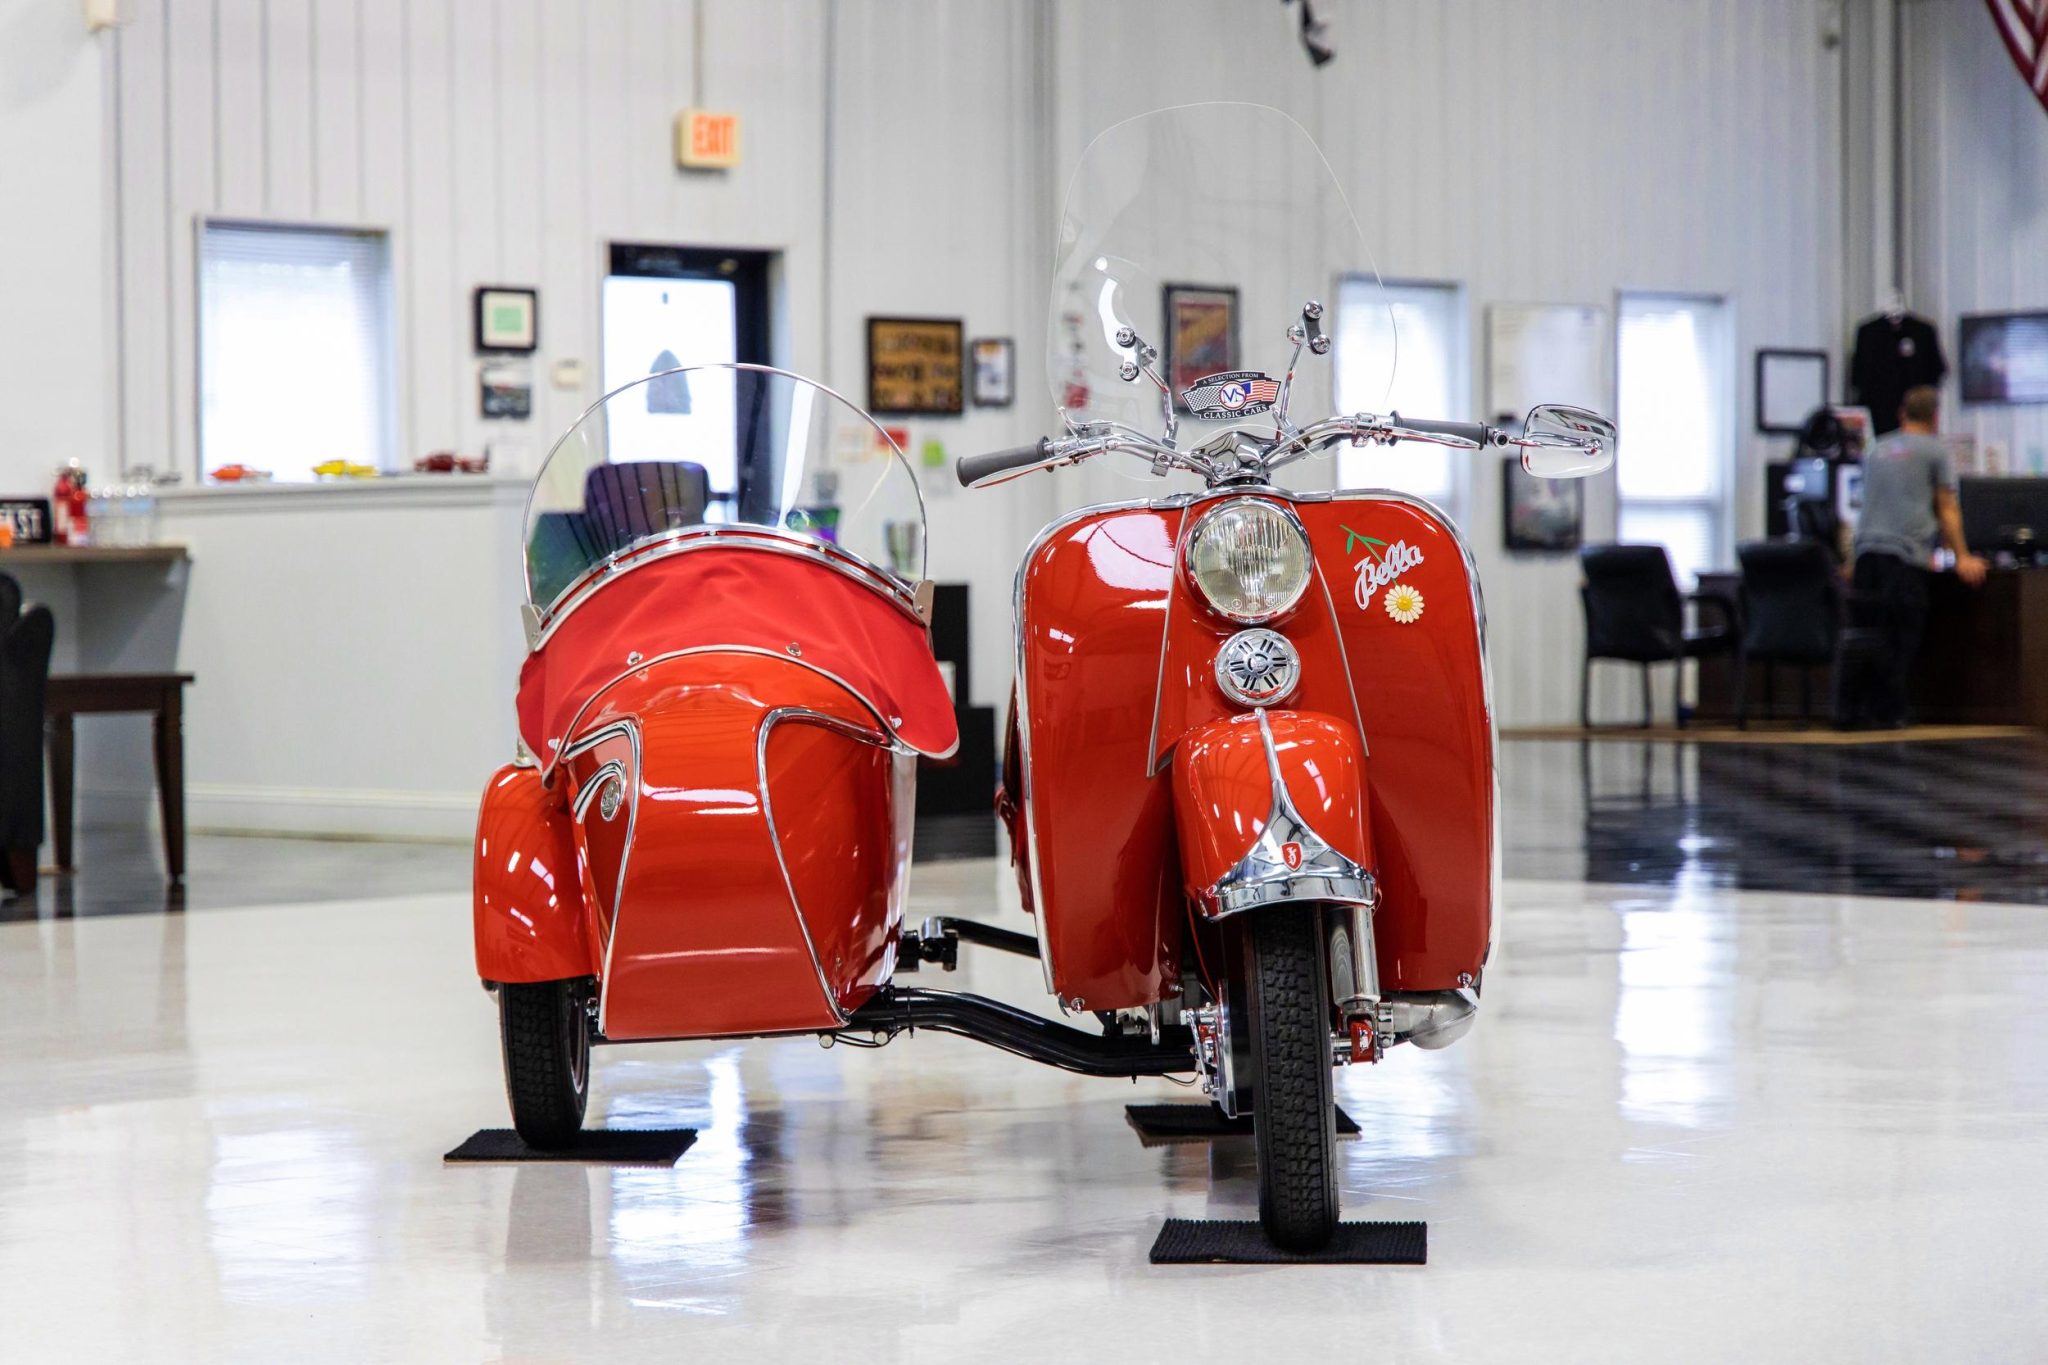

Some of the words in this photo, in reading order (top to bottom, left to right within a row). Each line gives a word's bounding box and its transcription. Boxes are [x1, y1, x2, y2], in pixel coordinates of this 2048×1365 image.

[692, 114, 736, 157] EXIT
[1208, 373, 1240, 383] SELECTION
[1203, 410, 1242, 419] CLASSIC
[1243, 404, 1267, 416] CARS
[1353, 539, 1425, 611] Bella
